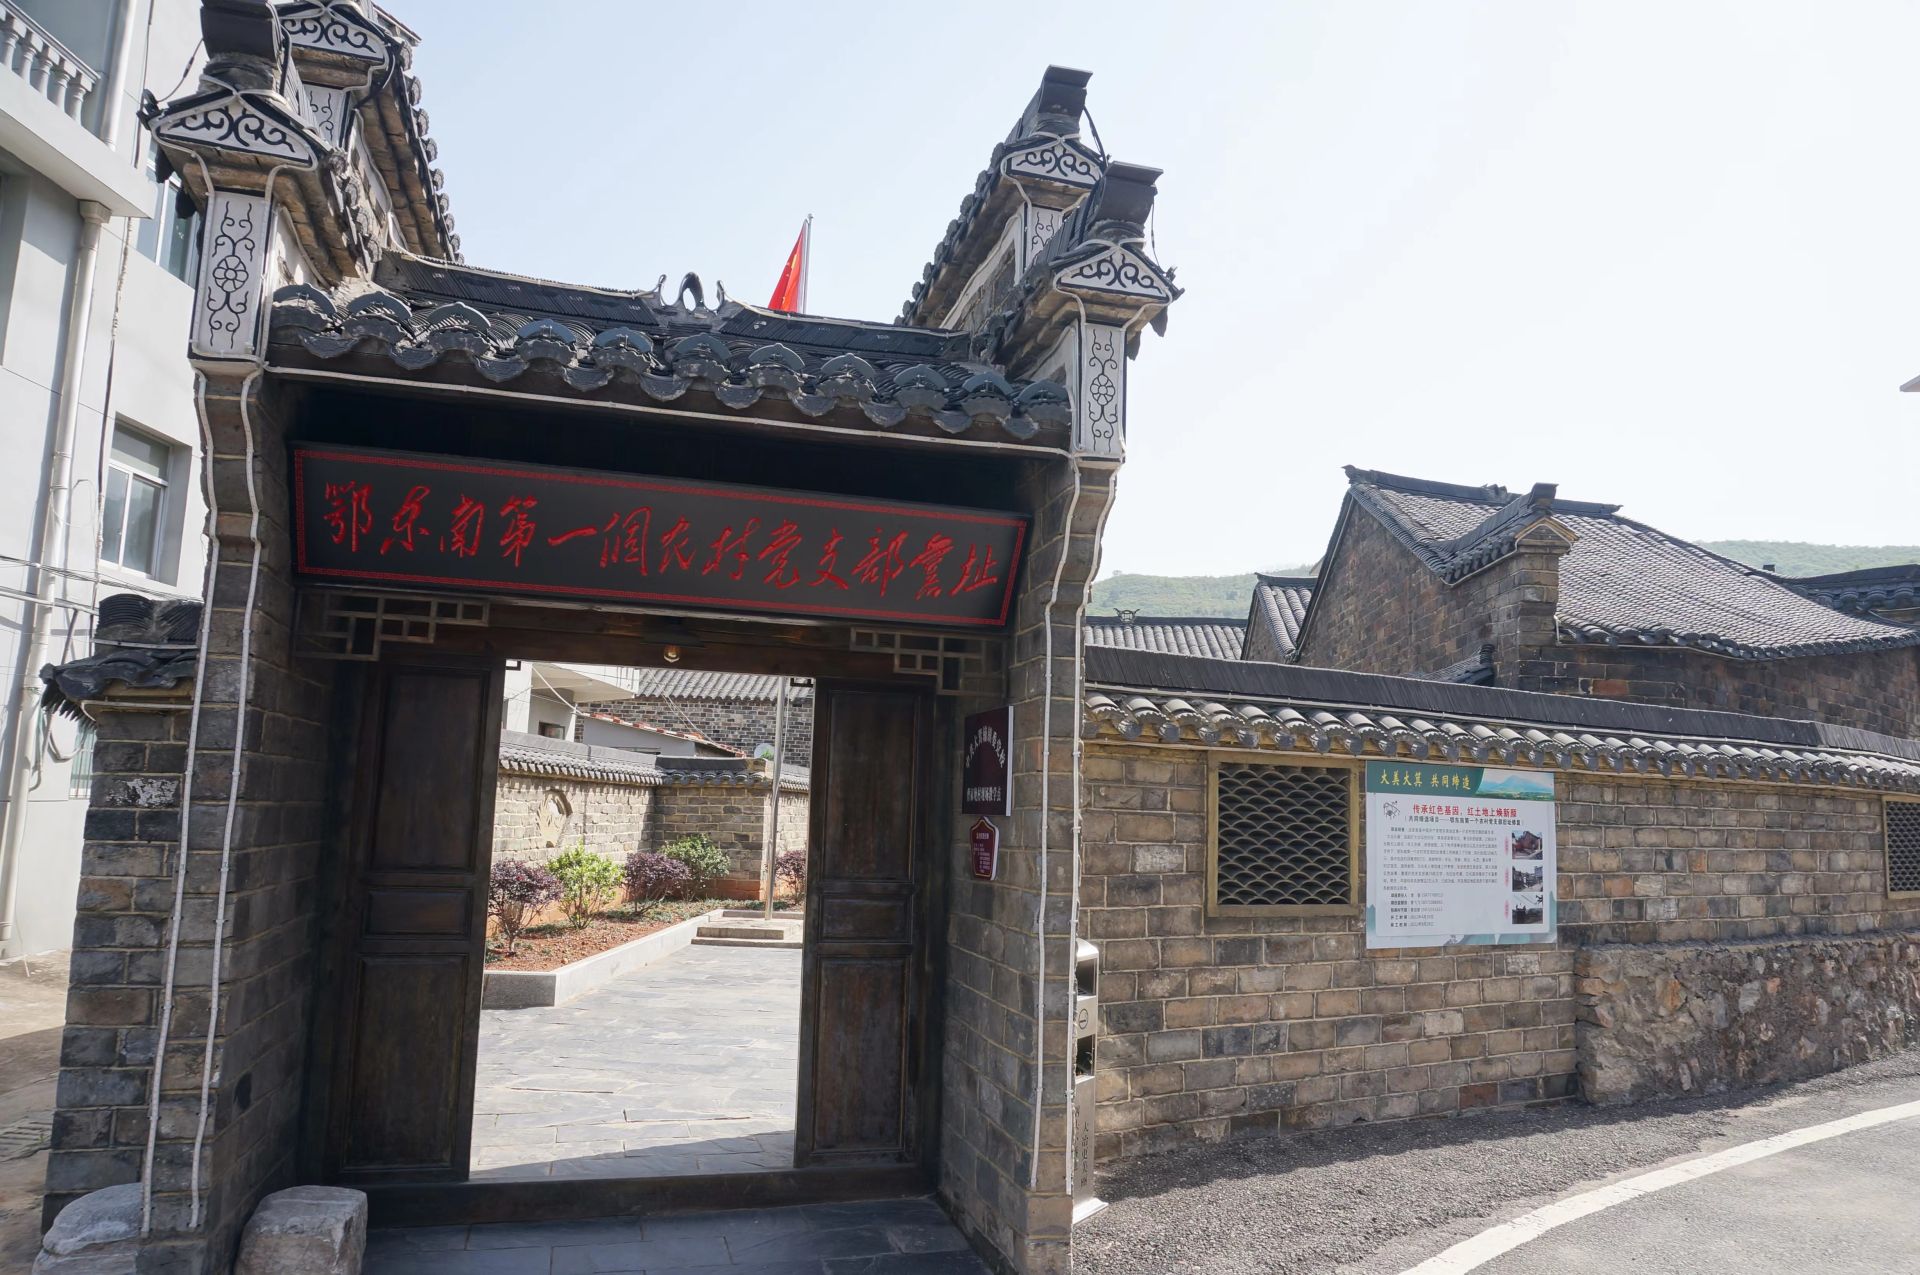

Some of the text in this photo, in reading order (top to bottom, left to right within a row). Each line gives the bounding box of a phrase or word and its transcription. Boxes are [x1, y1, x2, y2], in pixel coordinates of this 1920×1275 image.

[1380, 769, 1471, 790] 大美大箕 共同缔造
